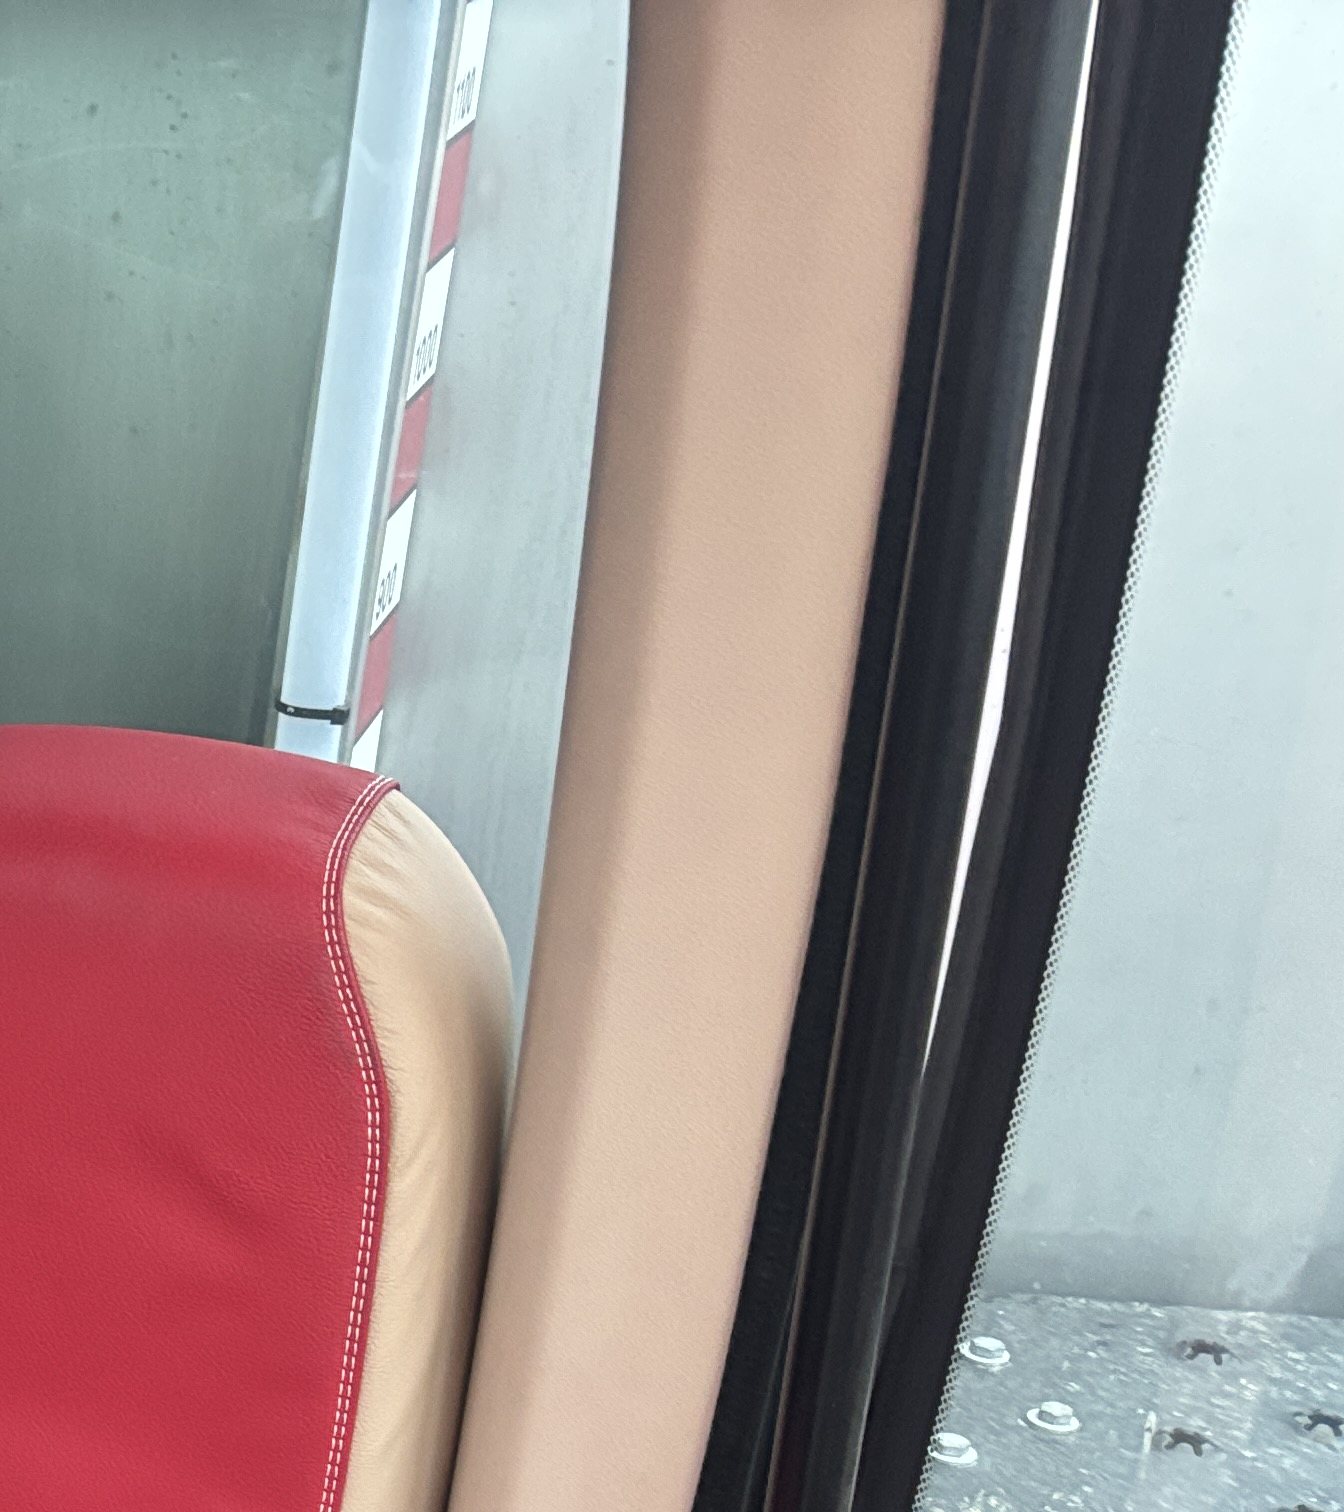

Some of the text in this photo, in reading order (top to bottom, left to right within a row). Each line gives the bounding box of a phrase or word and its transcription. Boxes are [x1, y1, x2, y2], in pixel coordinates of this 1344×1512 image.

[454, 66, 475, 125] 1100
[413, 324, 437, 385] 1000
[376, 563, 398, 620] 900
